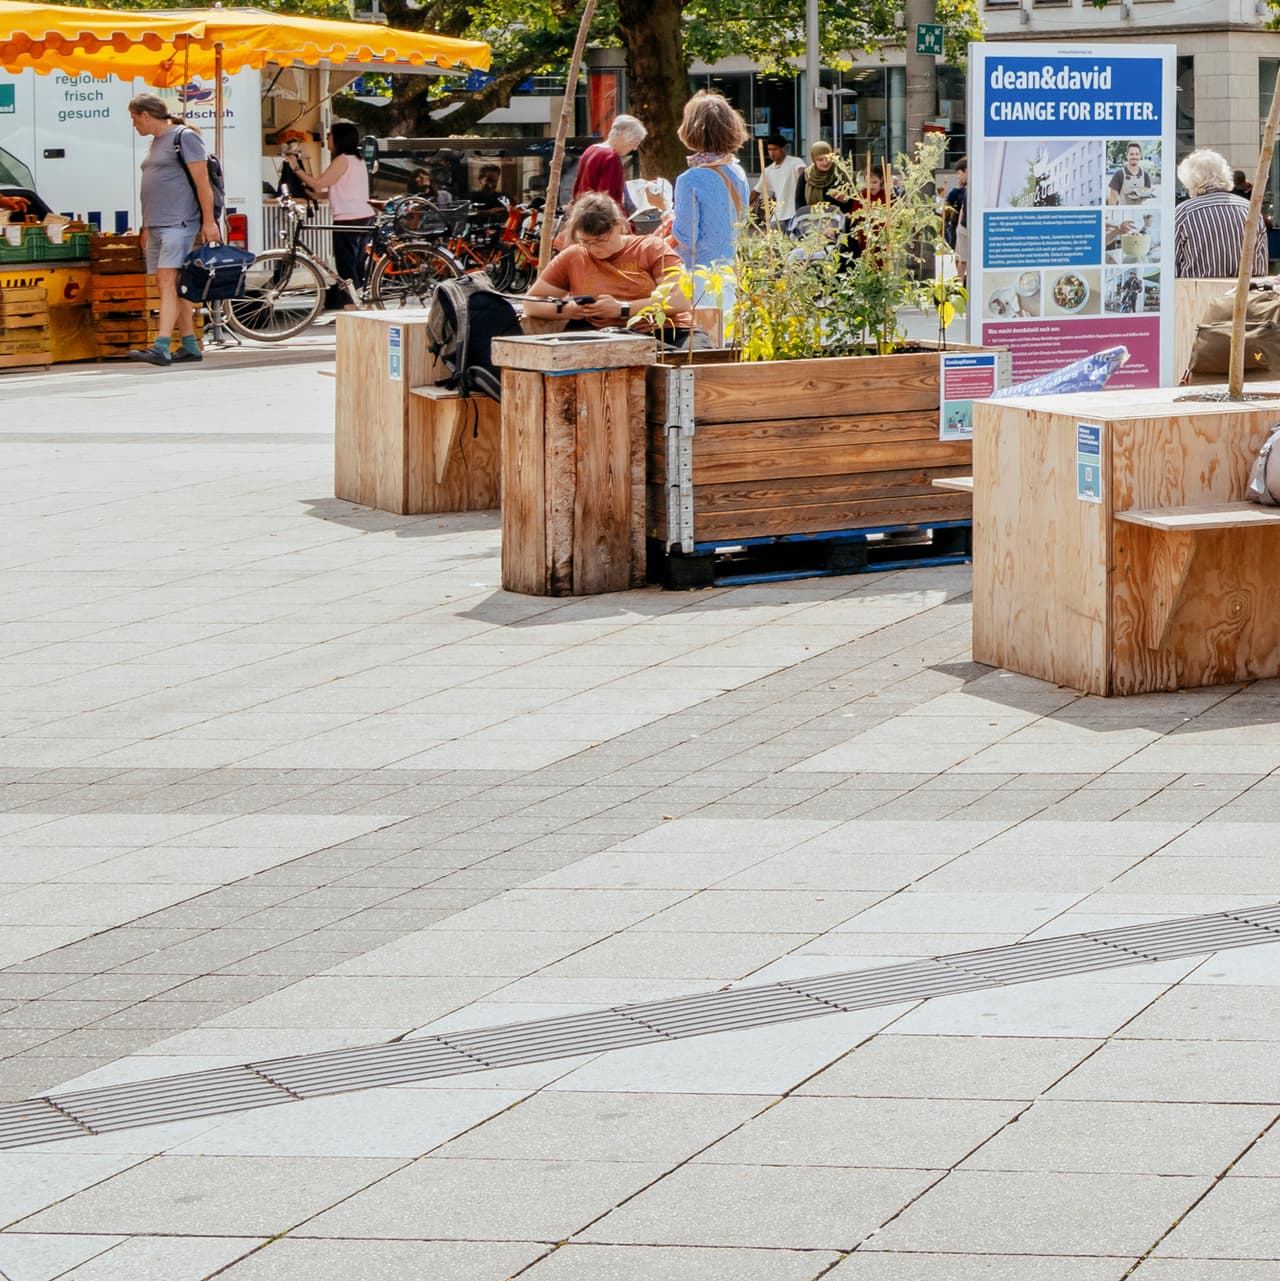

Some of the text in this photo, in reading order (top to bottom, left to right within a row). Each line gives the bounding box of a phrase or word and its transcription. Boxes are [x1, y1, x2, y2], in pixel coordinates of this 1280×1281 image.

[990, 65, 1112, 90] dean&david
[64, 89, 104, 102] frisch
[58, 106, 110, 122] gesund
[990, 101, 1159, 121] CHANGE FOR BETTER.
